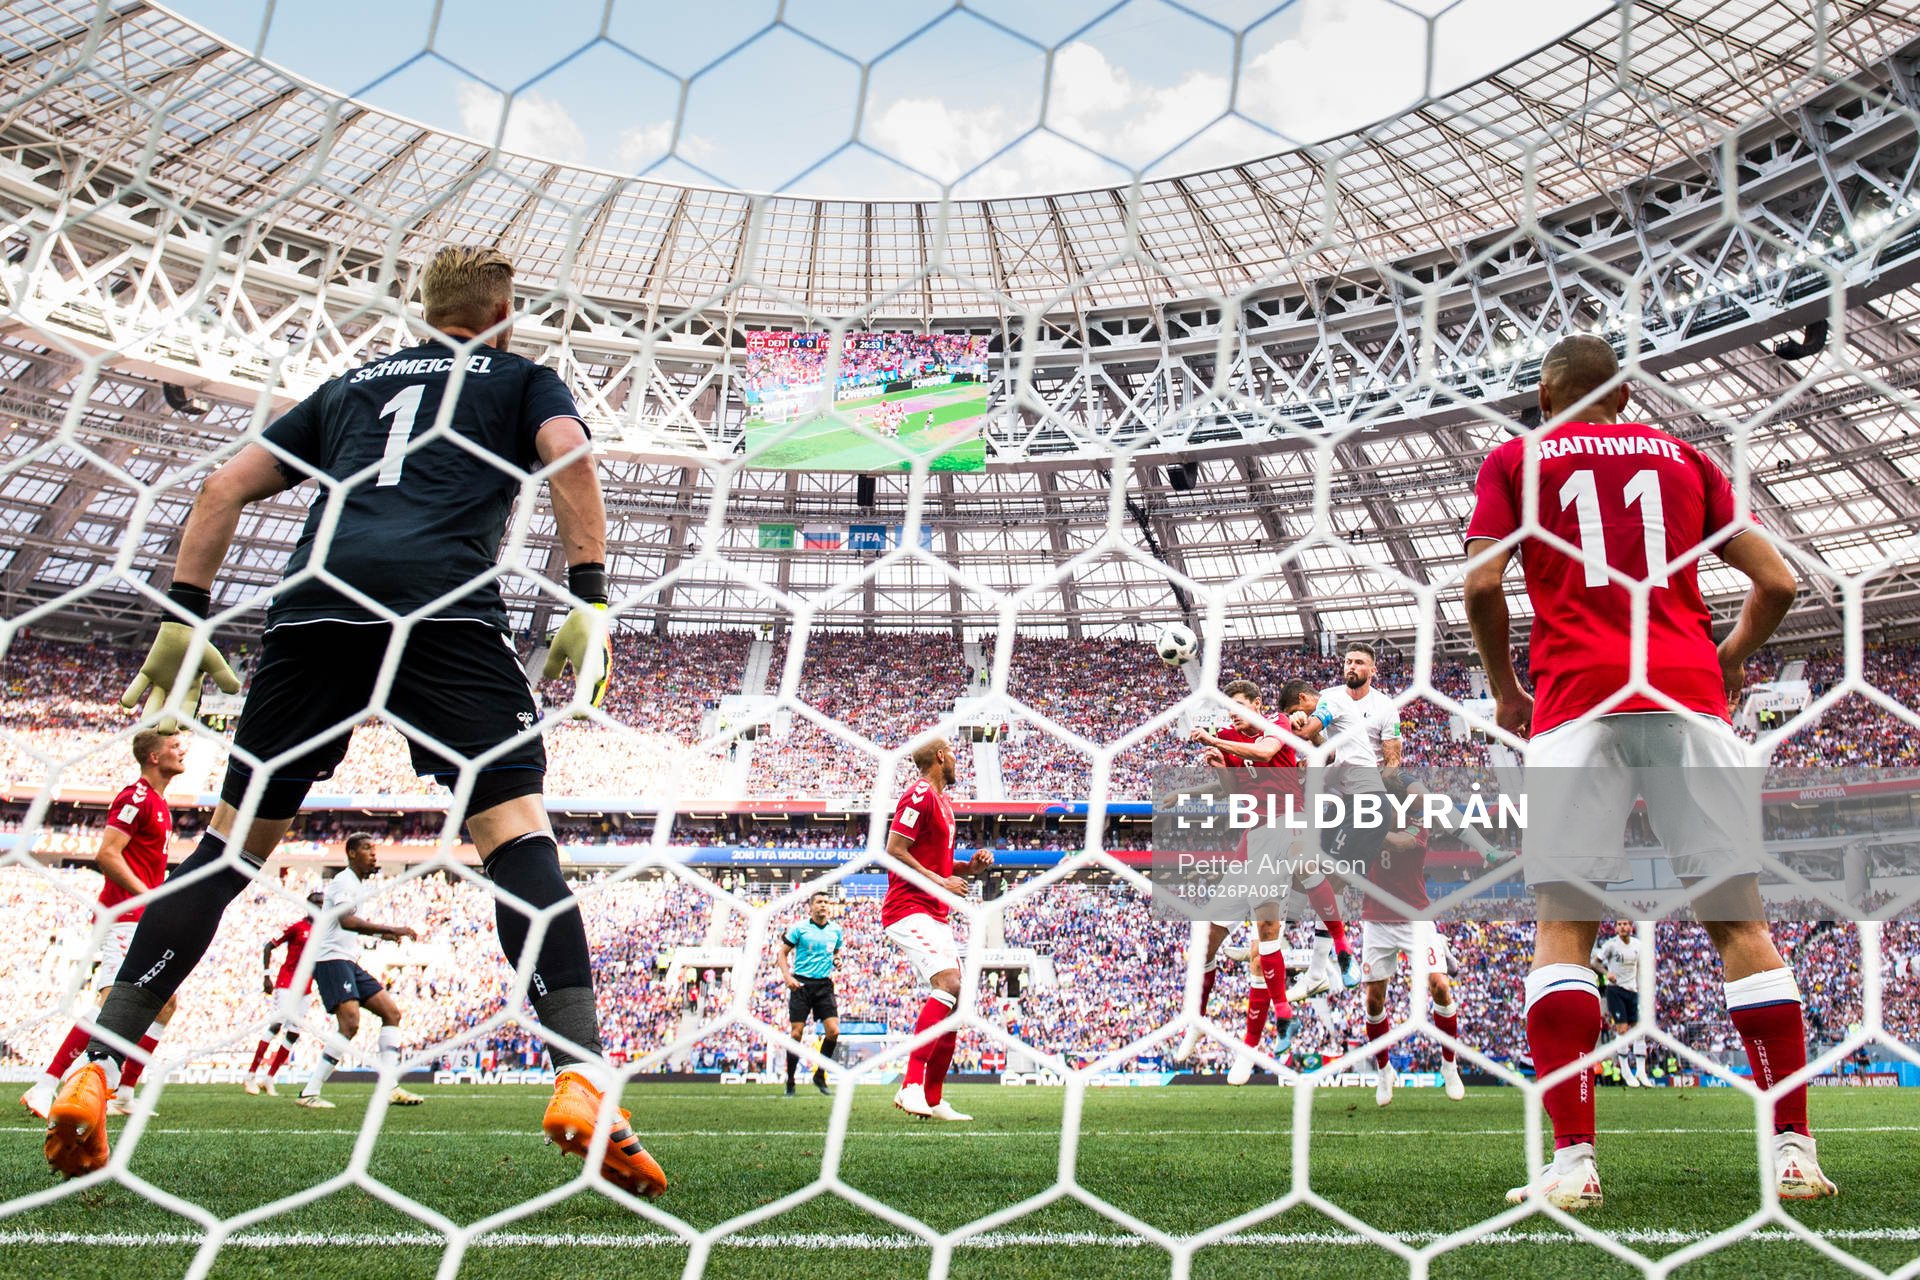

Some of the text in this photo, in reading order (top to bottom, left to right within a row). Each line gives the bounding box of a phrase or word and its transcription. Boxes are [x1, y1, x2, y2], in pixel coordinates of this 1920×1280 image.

[767, 339, 786, 347] DEN
[859, 340, 881, 349] 26:53
[350, 355, 492, 383] SCHMEICEL
[375, 384, 426, 487] 1
[1558, 469, 1669, 589] 11
[854, 532, 881, 542] FIFA
[1800, 787, 1846, 800] МОСКВА
[731, 852, 755, 861] 2018
[756, 852, 777, 861] FIFA
[778, 851, 814, 861] WORLD
[815, 851, 837, 861] CUP
[1380, 850, 1392, 870] 8
